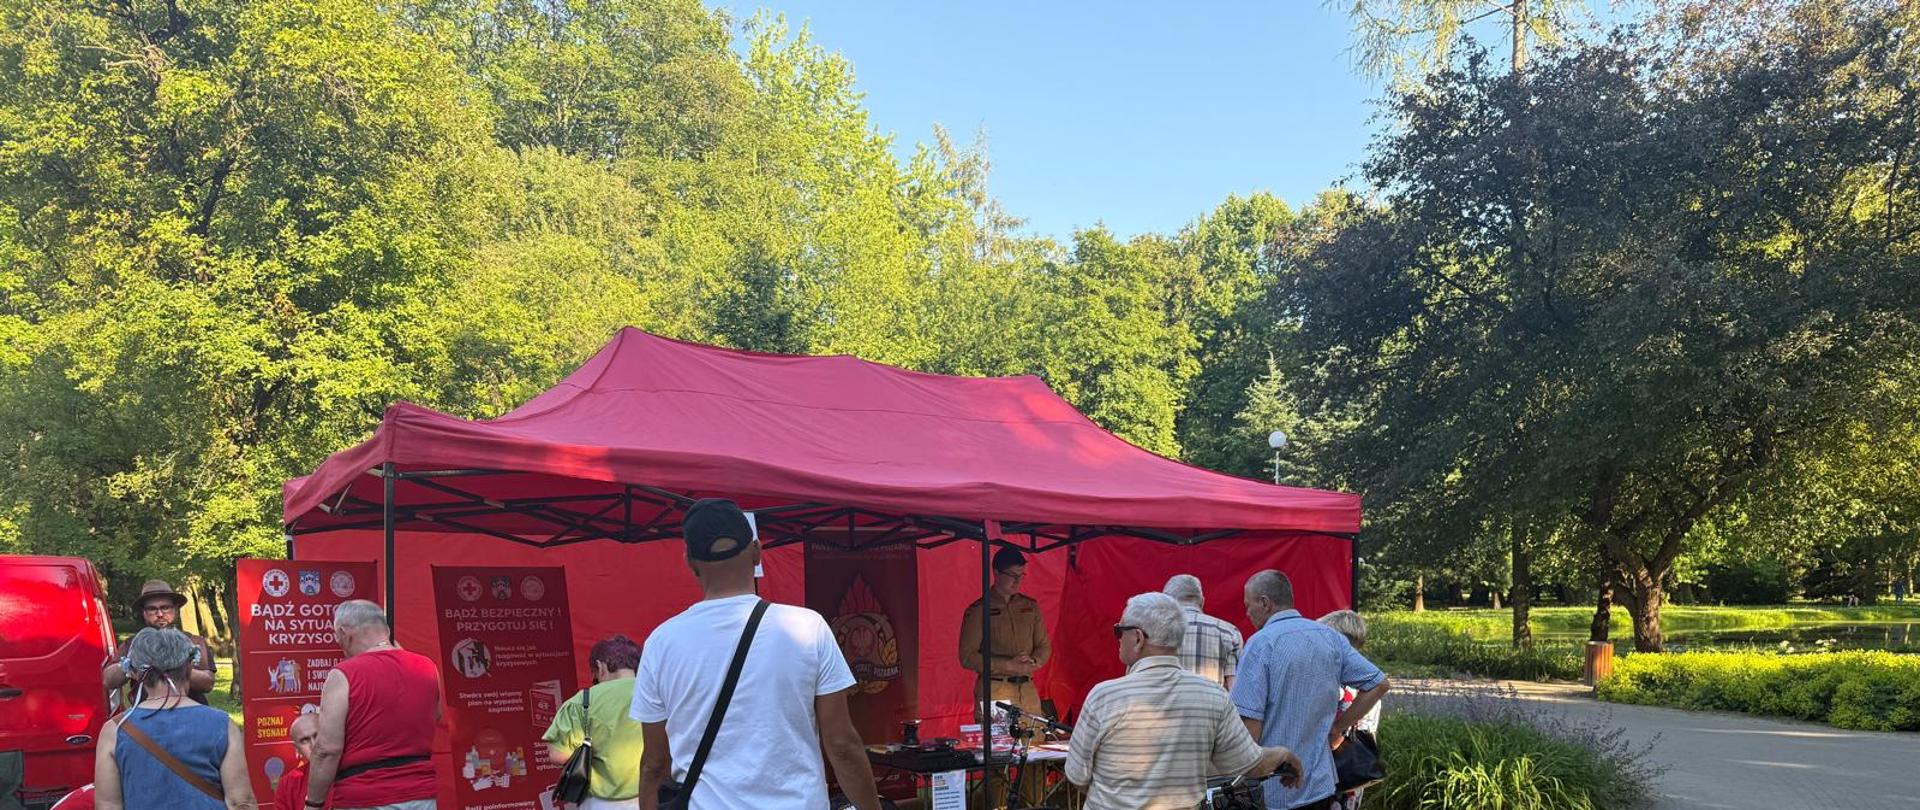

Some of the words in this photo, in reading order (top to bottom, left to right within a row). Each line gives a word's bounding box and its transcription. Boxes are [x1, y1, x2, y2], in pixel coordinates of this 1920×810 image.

[251, 601, 295, 619] BĄDŹ
[446, 608, 478, 619] BĄDŹ
[482, 608, 555, 617] BEZPIECZNY
[265, 620, 286, 631] NA
[457, 622, 525, 631] PRZYGOTUJ
[530, 621, 546, 631] SIĘ
[257, 716, 284, 727] POZNAJ
